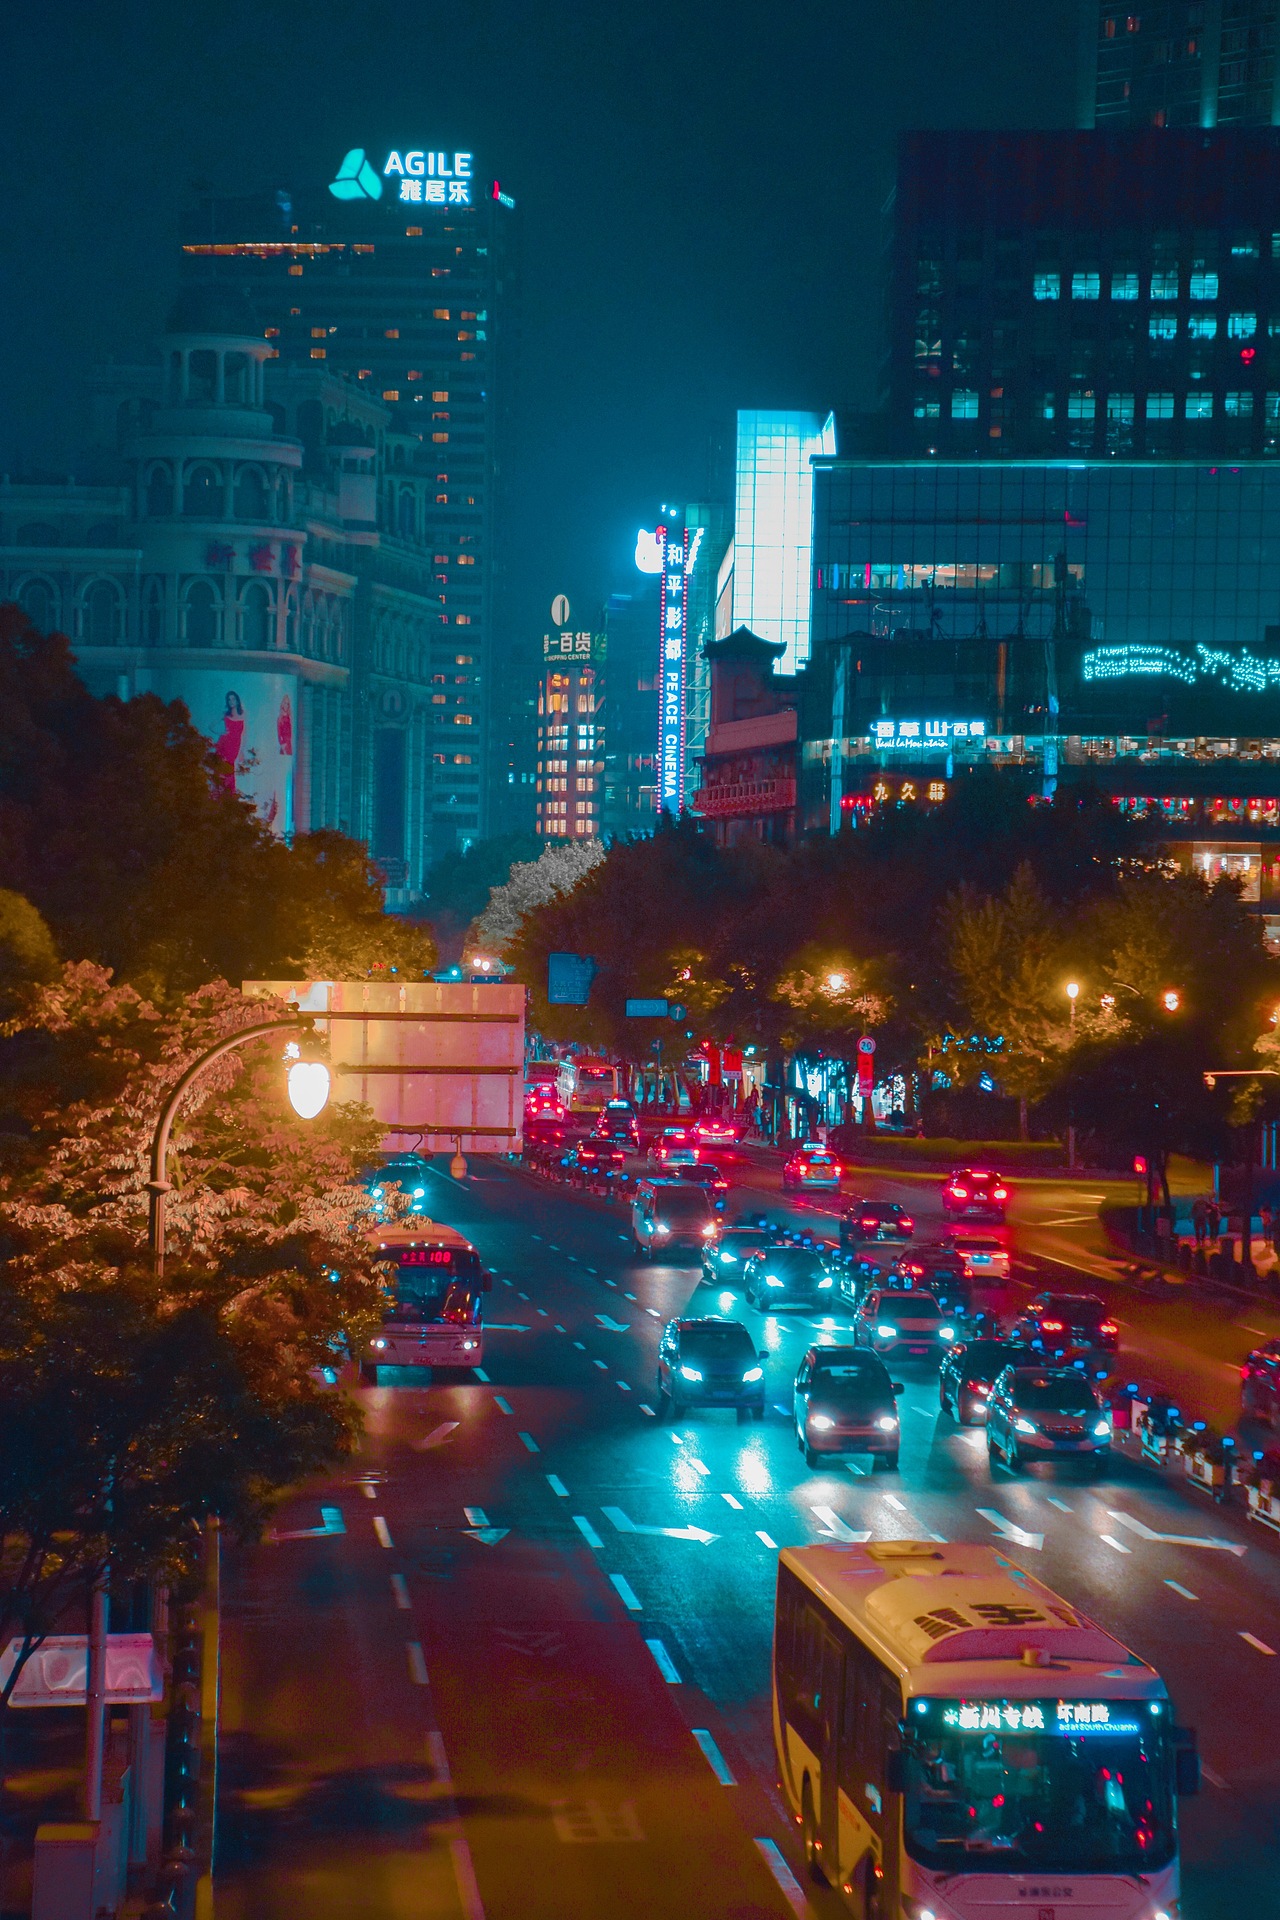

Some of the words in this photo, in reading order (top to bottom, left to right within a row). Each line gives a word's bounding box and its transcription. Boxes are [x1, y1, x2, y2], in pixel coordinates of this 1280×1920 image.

[384, 151, 471, 177] AGILE
[400, 178, 469, 203] 雅居乐
[666, 672, 678, 725] PEACE
[664, 734, 677, 798] CINEMA
[430, 1251, 451, 1263] 108
